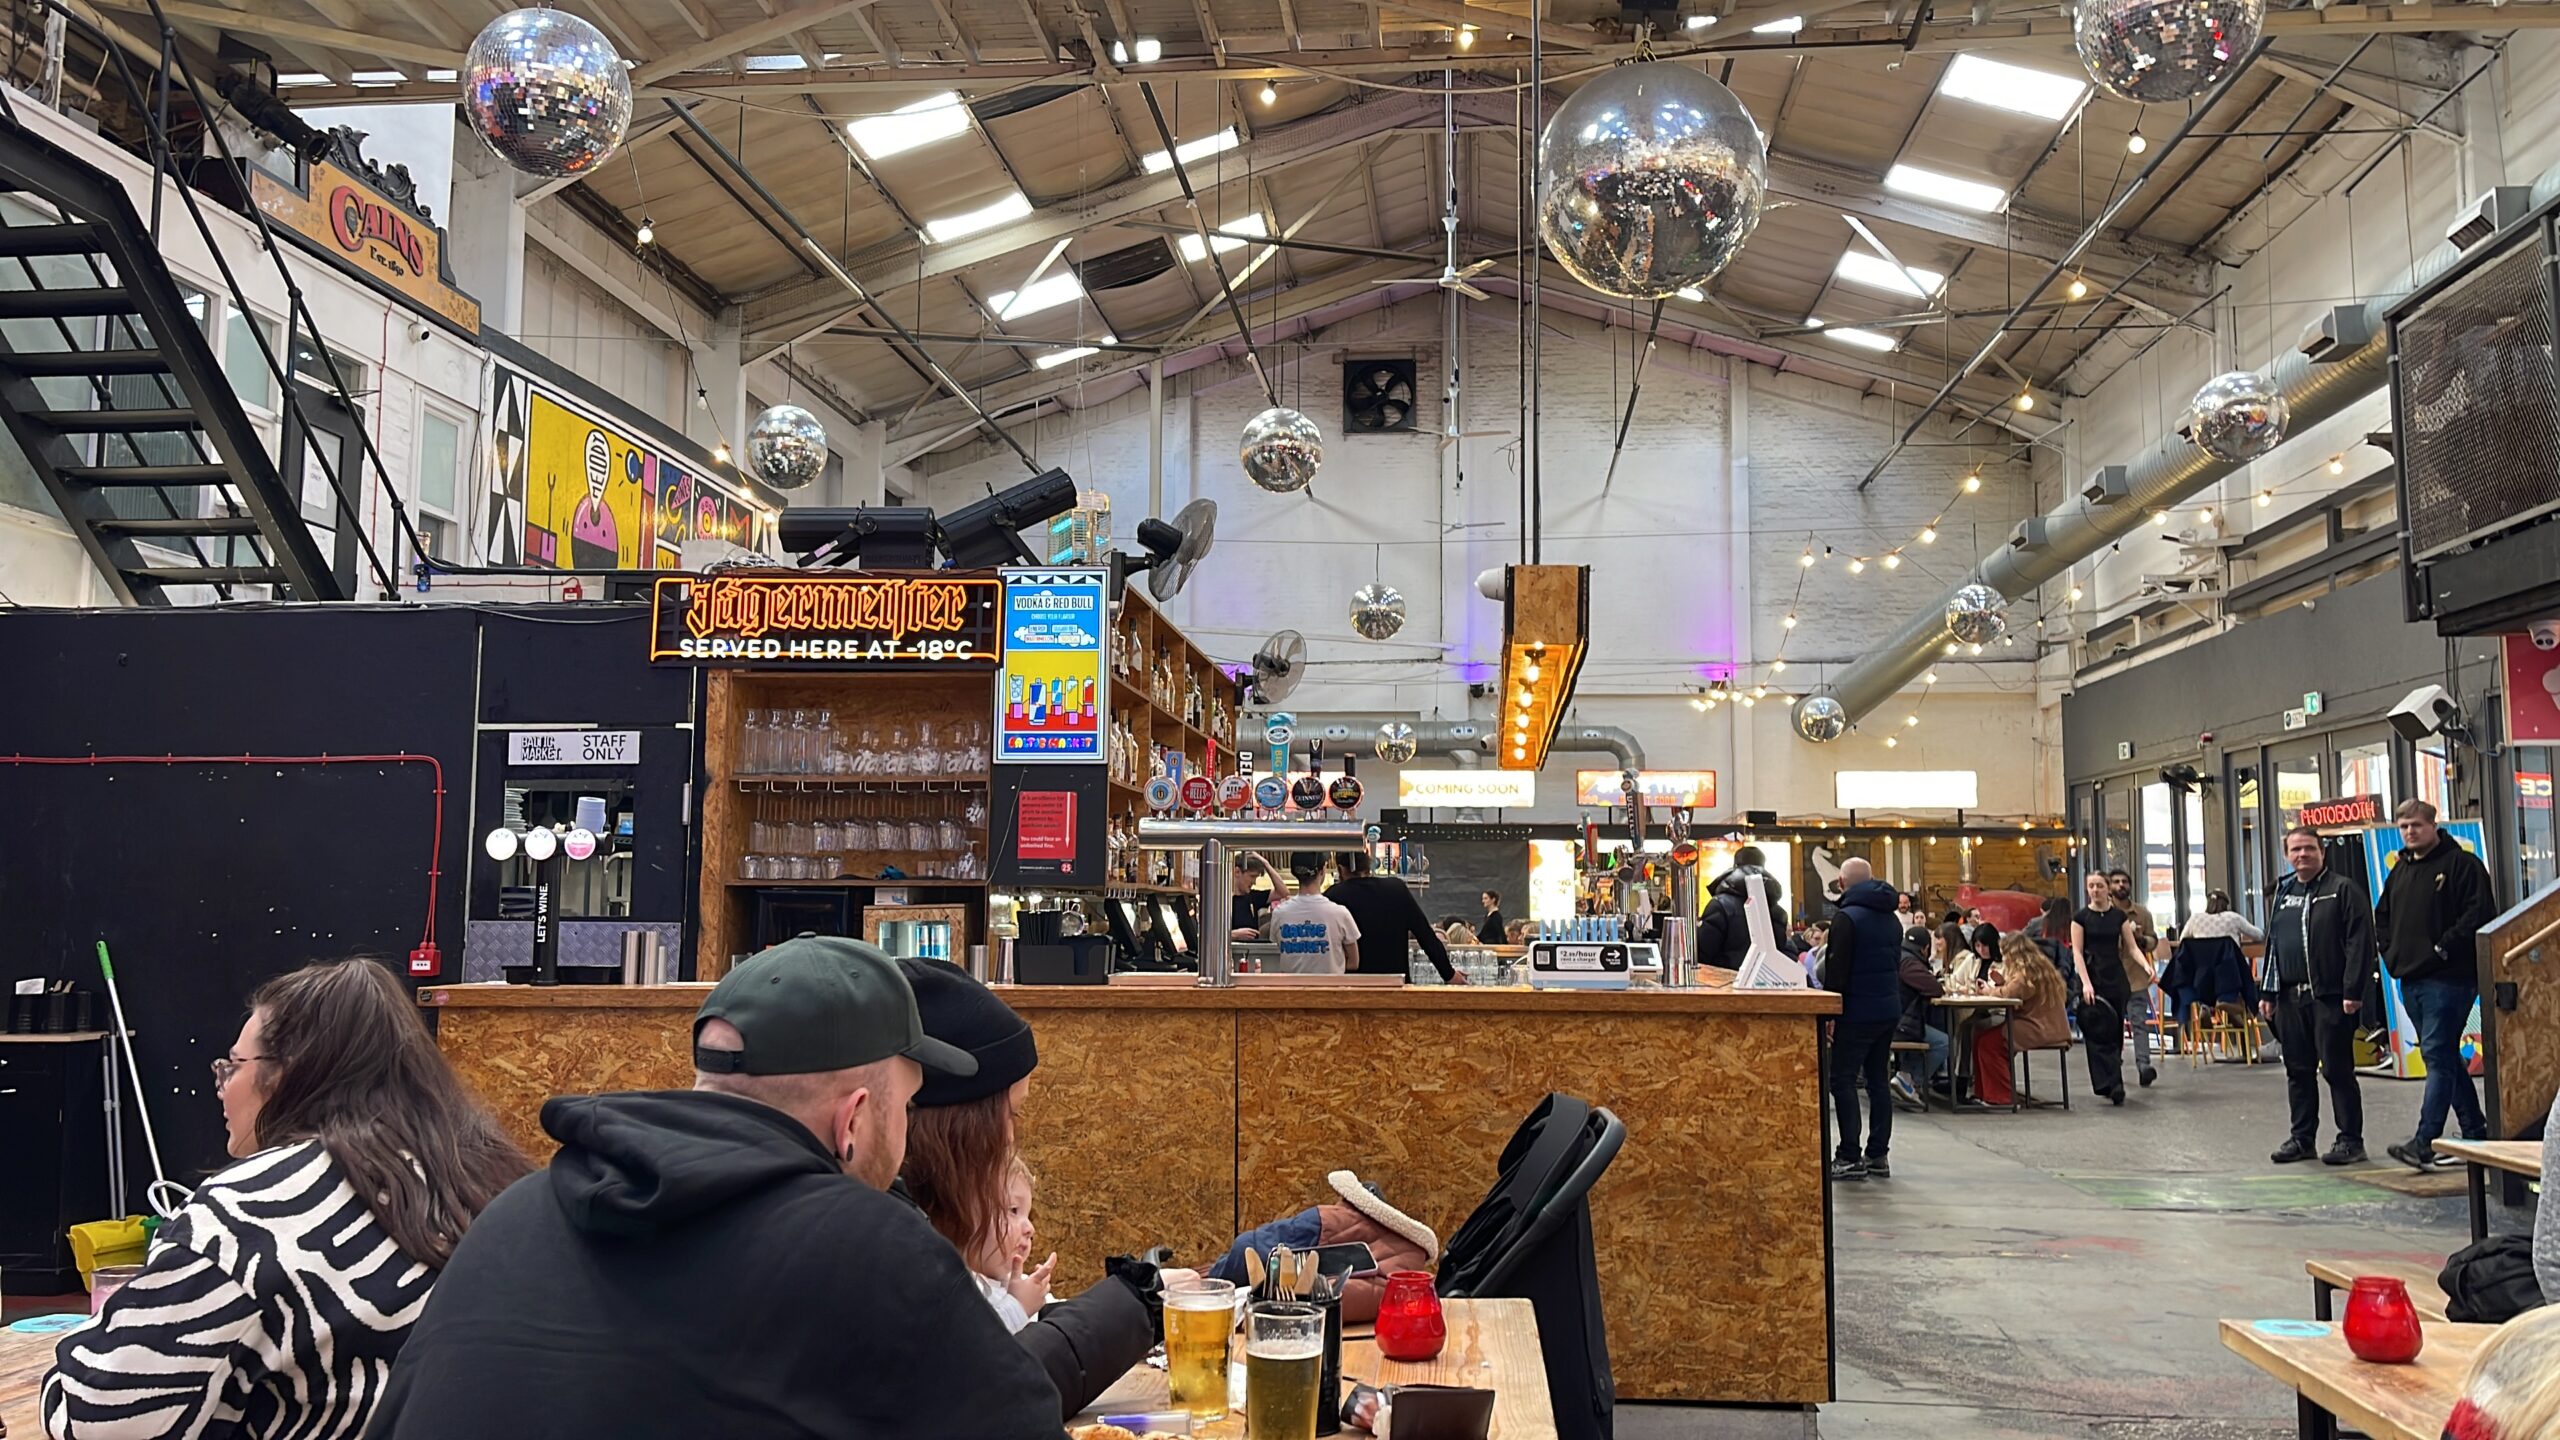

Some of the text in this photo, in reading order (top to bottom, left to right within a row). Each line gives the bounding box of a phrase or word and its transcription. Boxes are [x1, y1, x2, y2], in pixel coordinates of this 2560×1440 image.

[329, 185, 424, 278] CAINS
[1015, 597, 1043, 609] VODKA
[1053, 597, 1070, 609] RED
[1071, 597, 1092, 609] BULL
[679, 638, 778, 660] SERVED
[789, 639, 859, 660] HERE
[866, 639, 902, 660] AT
[583, 734, 627, 748] STAFF
[1048, 737, 1093, 749] MARKET
[582, 747, 624, 761] ONLY
[1415, 784, 1519, 795] COMING SOON
[2300, 799, 2376, 827] PHOTOBOOTH
[536, 915, 547, 943] LET'S
